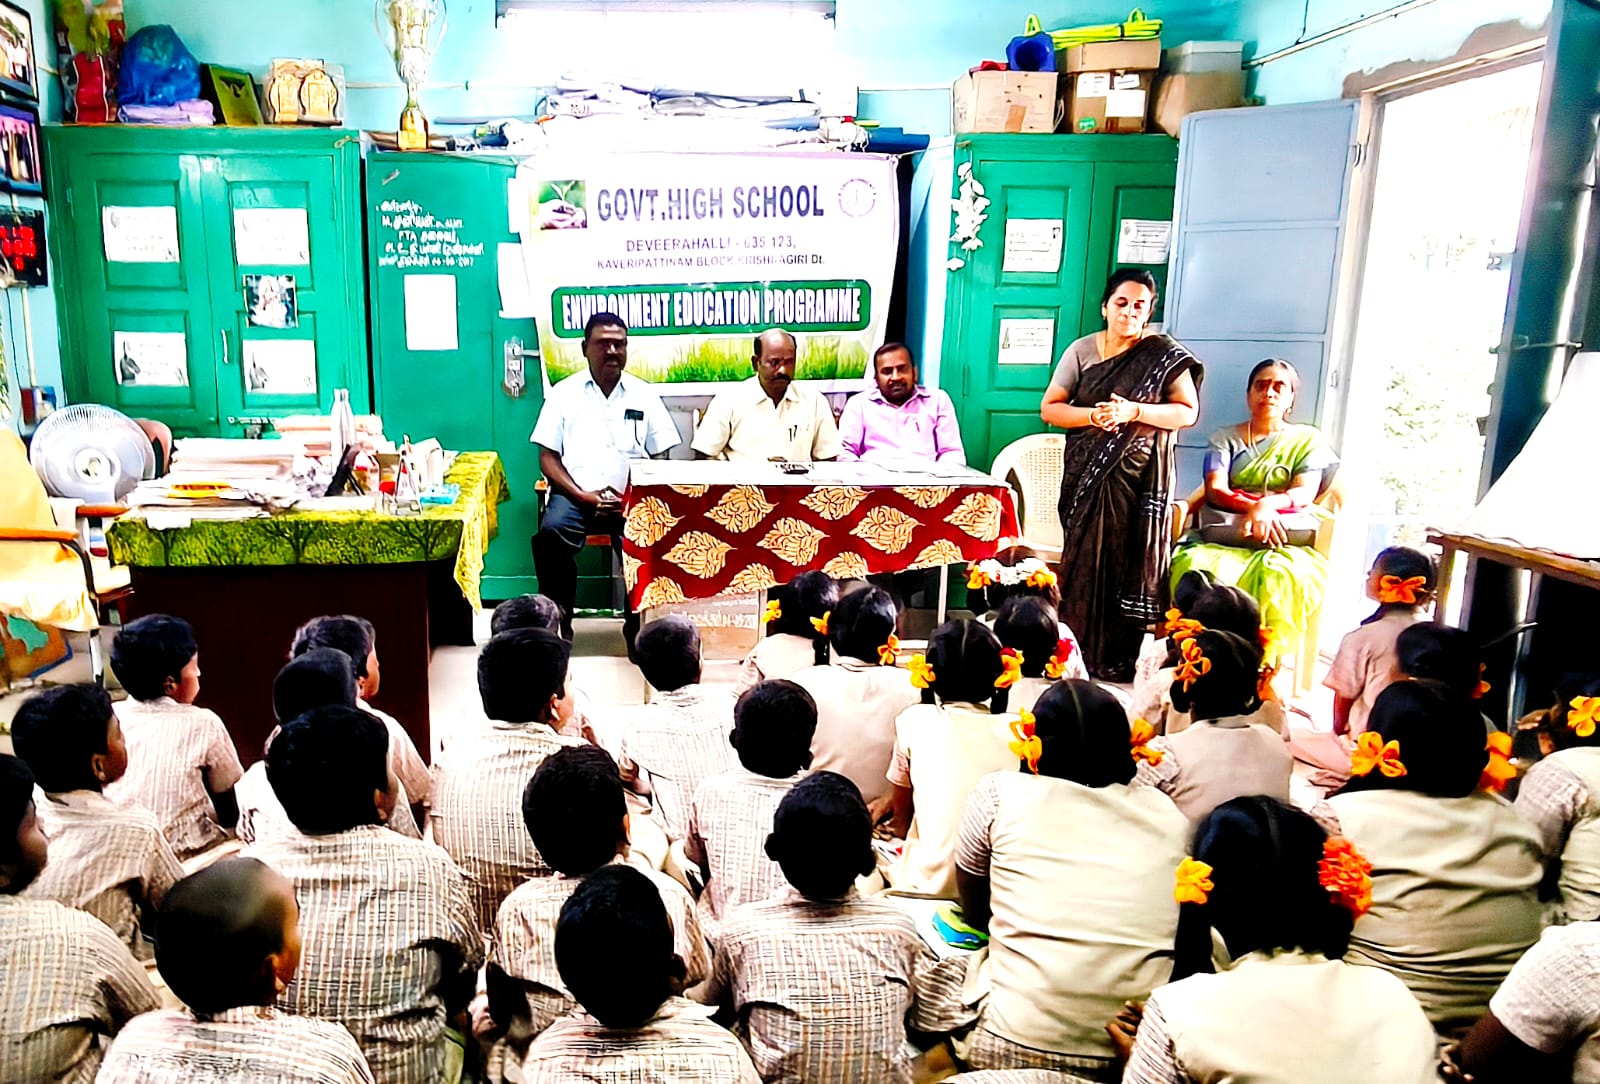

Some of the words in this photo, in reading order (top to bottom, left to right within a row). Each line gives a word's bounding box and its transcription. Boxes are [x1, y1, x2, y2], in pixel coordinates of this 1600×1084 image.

[733, 184, 824, 219] SCHOOL
[626, 237, 731, 252] DEVEERAHALLI
[744, 235, 766, 249] 635
[597, 257, 693, 270] KAVERIPATTINAM
[561, 291, 670, 330] ENVIRONMENT
[673, 289, 761, 327] EDUCATION
[763, 287, 861, 325] PROGRAMME
